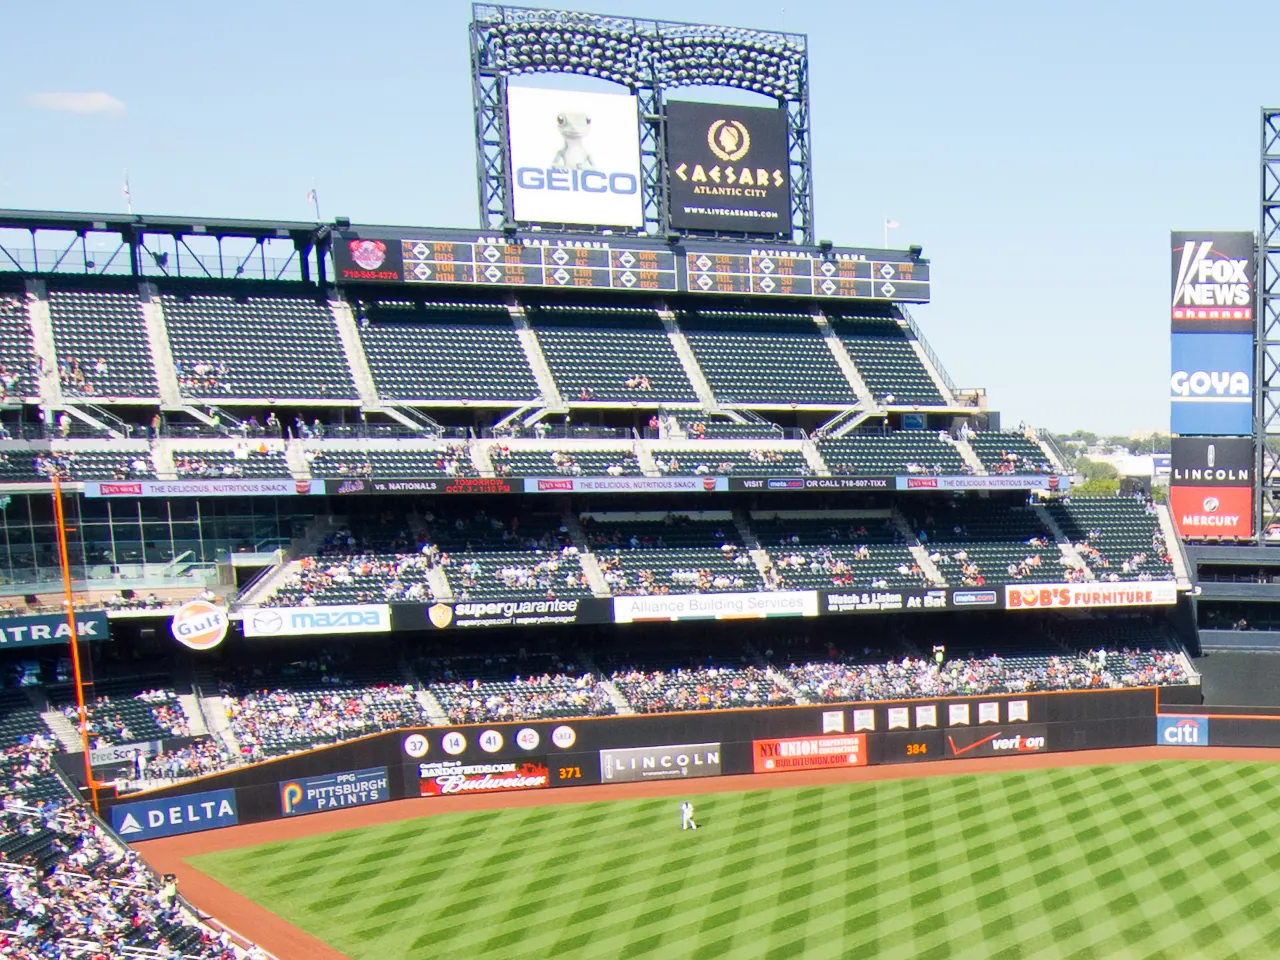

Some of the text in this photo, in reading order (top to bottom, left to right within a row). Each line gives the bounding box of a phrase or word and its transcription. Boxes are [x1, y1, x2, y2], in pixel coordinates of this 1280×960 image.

[517, 167, 637, 195] GEICO
[675, 162, 784, 187] CAESARS
[694, 186, 767, 198] ATLANTIC CITY
[1198, 259, 1248, 283] FOX
[1183, 283, 1250, 306] NEWS
[1174, 309, 1250, 319] channel
[1170, 371, 1250, 396] GOYA
[1174, 469, 1249, 480] LINCOLN
[168, 485, 212, 494] DELICIOUS,
[389, 482, 437, 491] NATIONALS
[1182, 515, 1239, 526] MERCURY
[827, 593, 902, 604] Watch & Listen
[907, 596, 946, 607] At Bat
[955, 593, 994, 602] mets.com
[1008, 588, 1071, 607] BOB'S
[1074, 591, 1153, 604] FURNITURE
[455, 599, 576, 618] superguarantee
[631, 596, 803, 613] Alliance Building Services
[177, 614, 221, 638] Gulf
[449, 738, 461, 748] 14
[485, 736, 497, 746] 41
[521, 733, 535, 743] 42
[992, 735, 1044, 751] verizon
[412, 740, 423, 751] 37
[906, 744, 927, 755] 384
[615, 752, 719, 770] LINCOLN
[776, 754, 847, 768] BUILDITUNION.COM
[337, 773, 356, 783] PPG
[560, 768, 581, 779] 371
[307, 778, 386, 800] PITTSBURGH
[436, 774, 547, 794] Budweiser
[317, 790, 379, 809] PAINTS
[148, 799, 234, 828] DELTA
